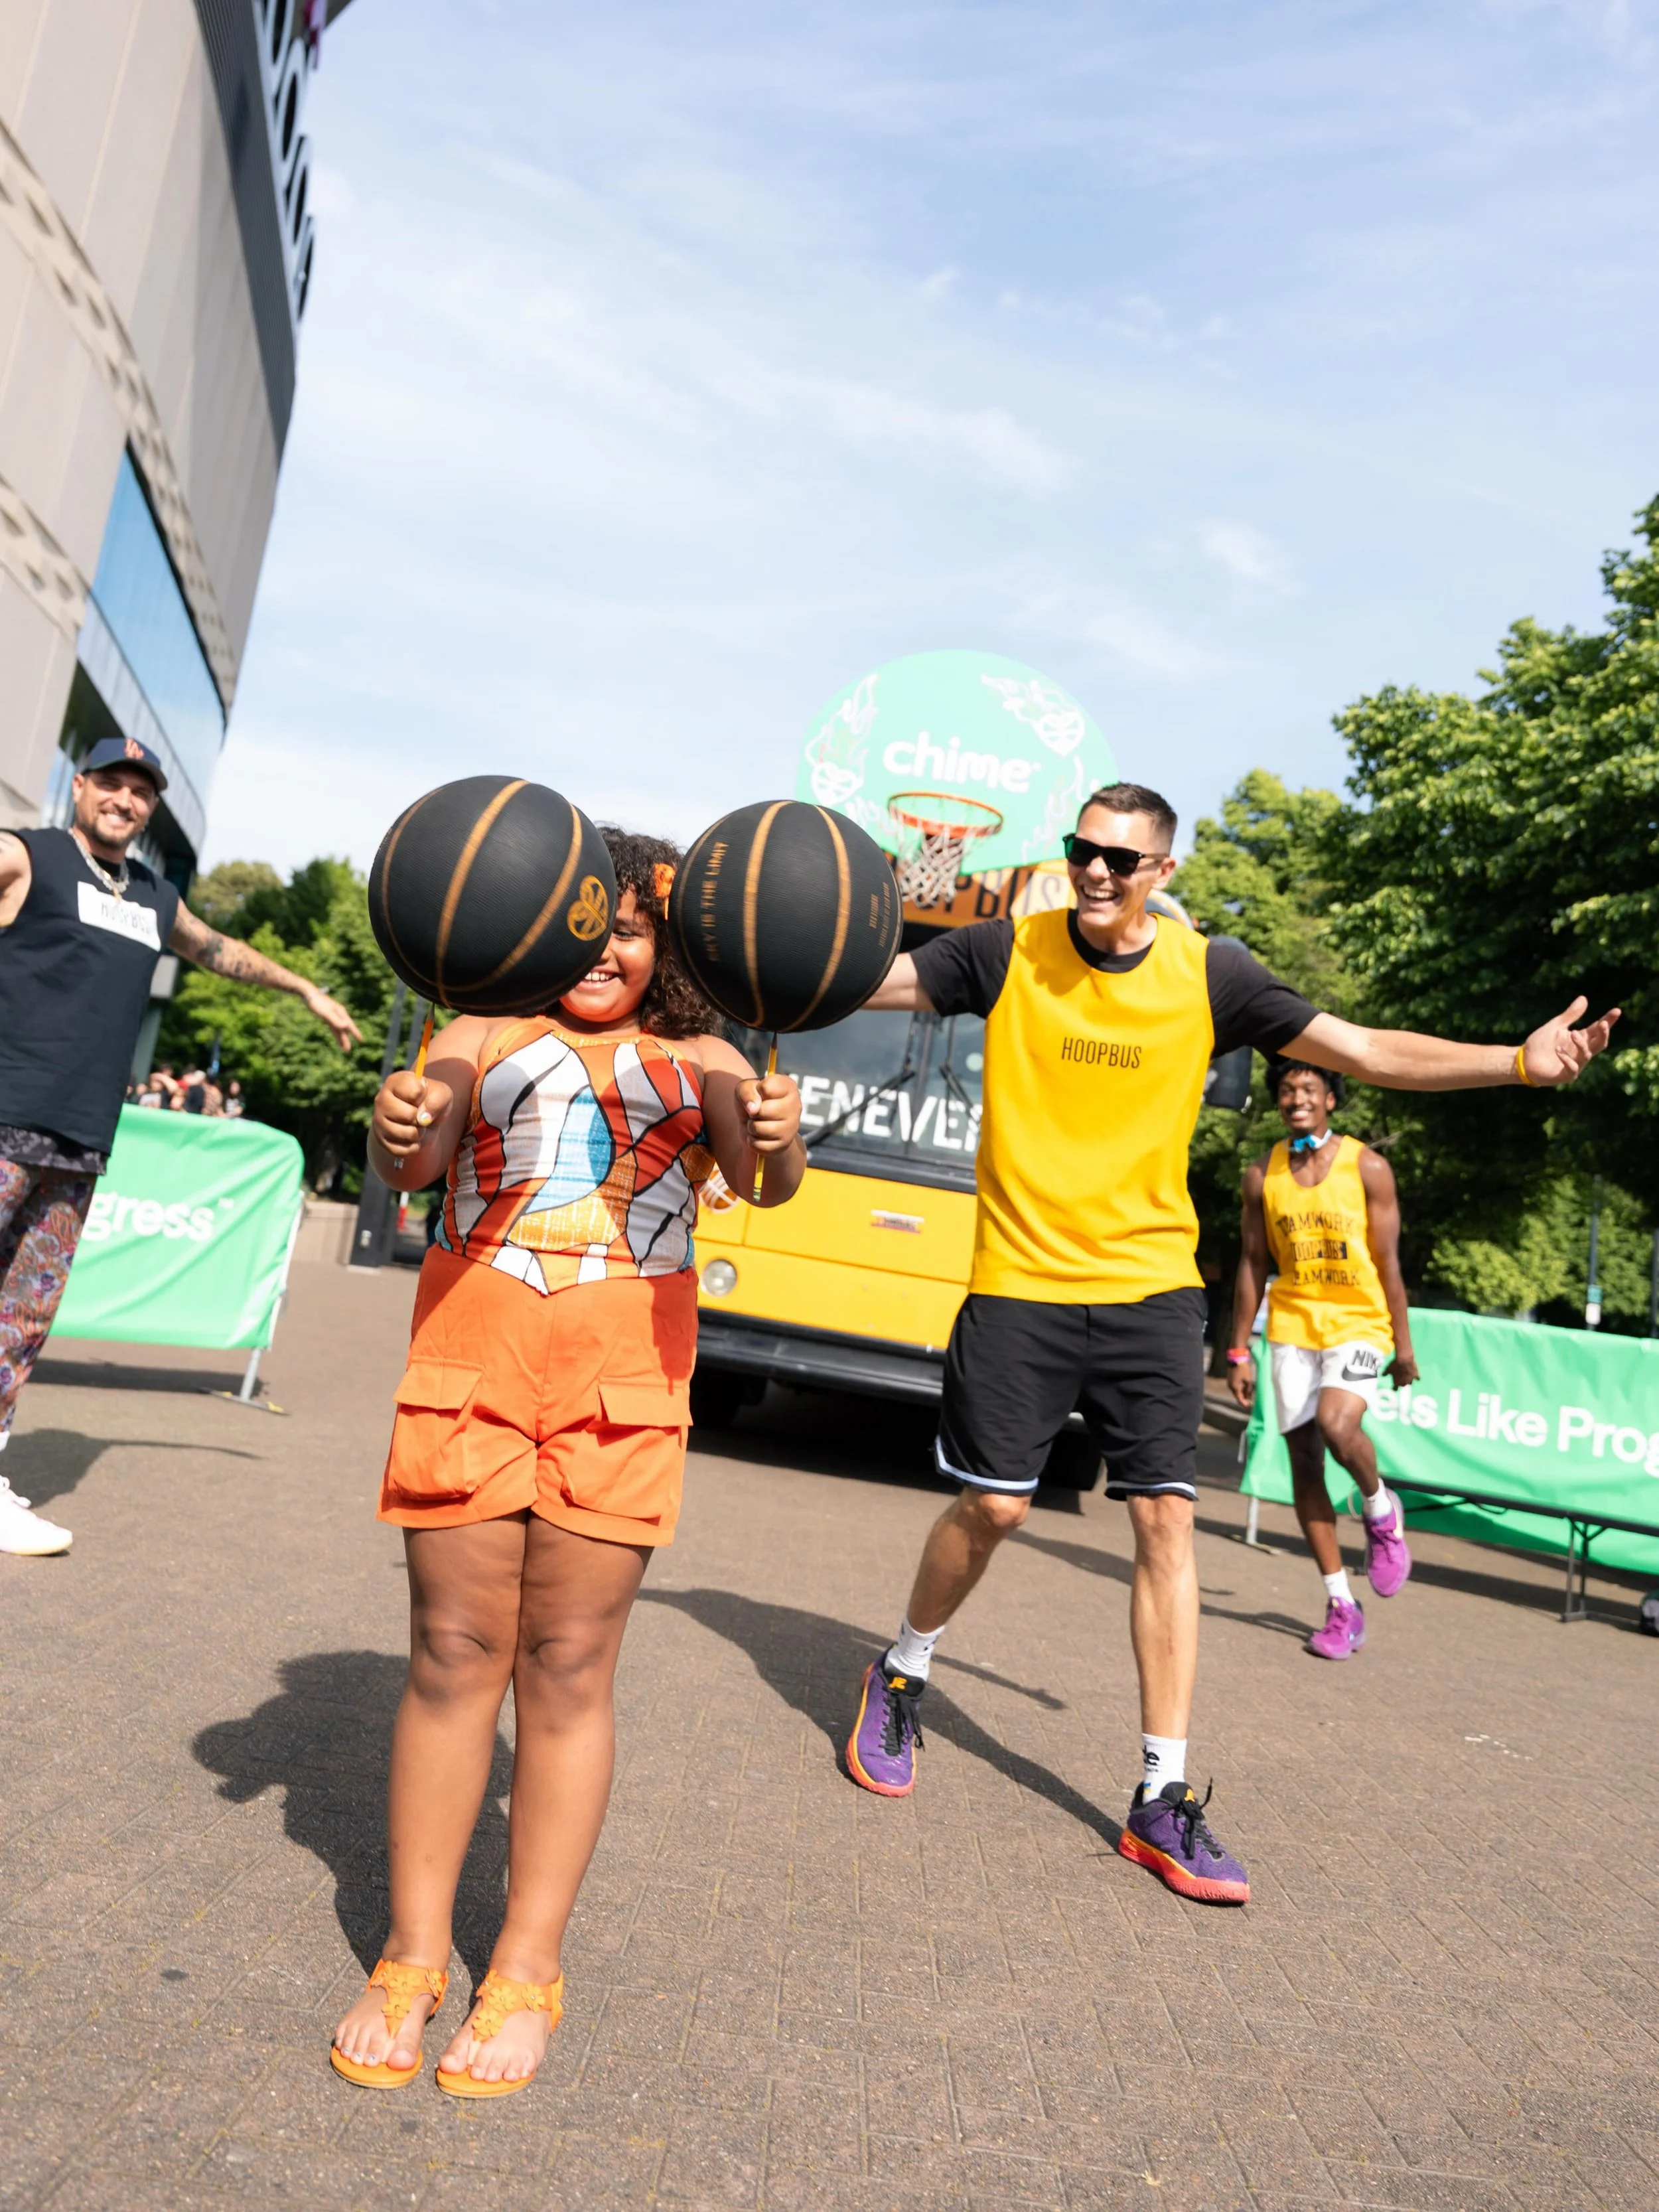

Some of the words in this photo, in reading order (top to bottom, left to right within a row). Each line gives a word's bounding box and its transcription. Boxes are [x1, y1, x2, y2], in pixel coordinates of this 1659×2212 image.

[883, 730, 1032, 792] chime
[704, 842, 729, 876] LIMIT
[700, 880, 718, 909] THE
[1061, 1036, 1142, 1069] HOOPBUS
[1447, 1388, 1548, 1448] Like
